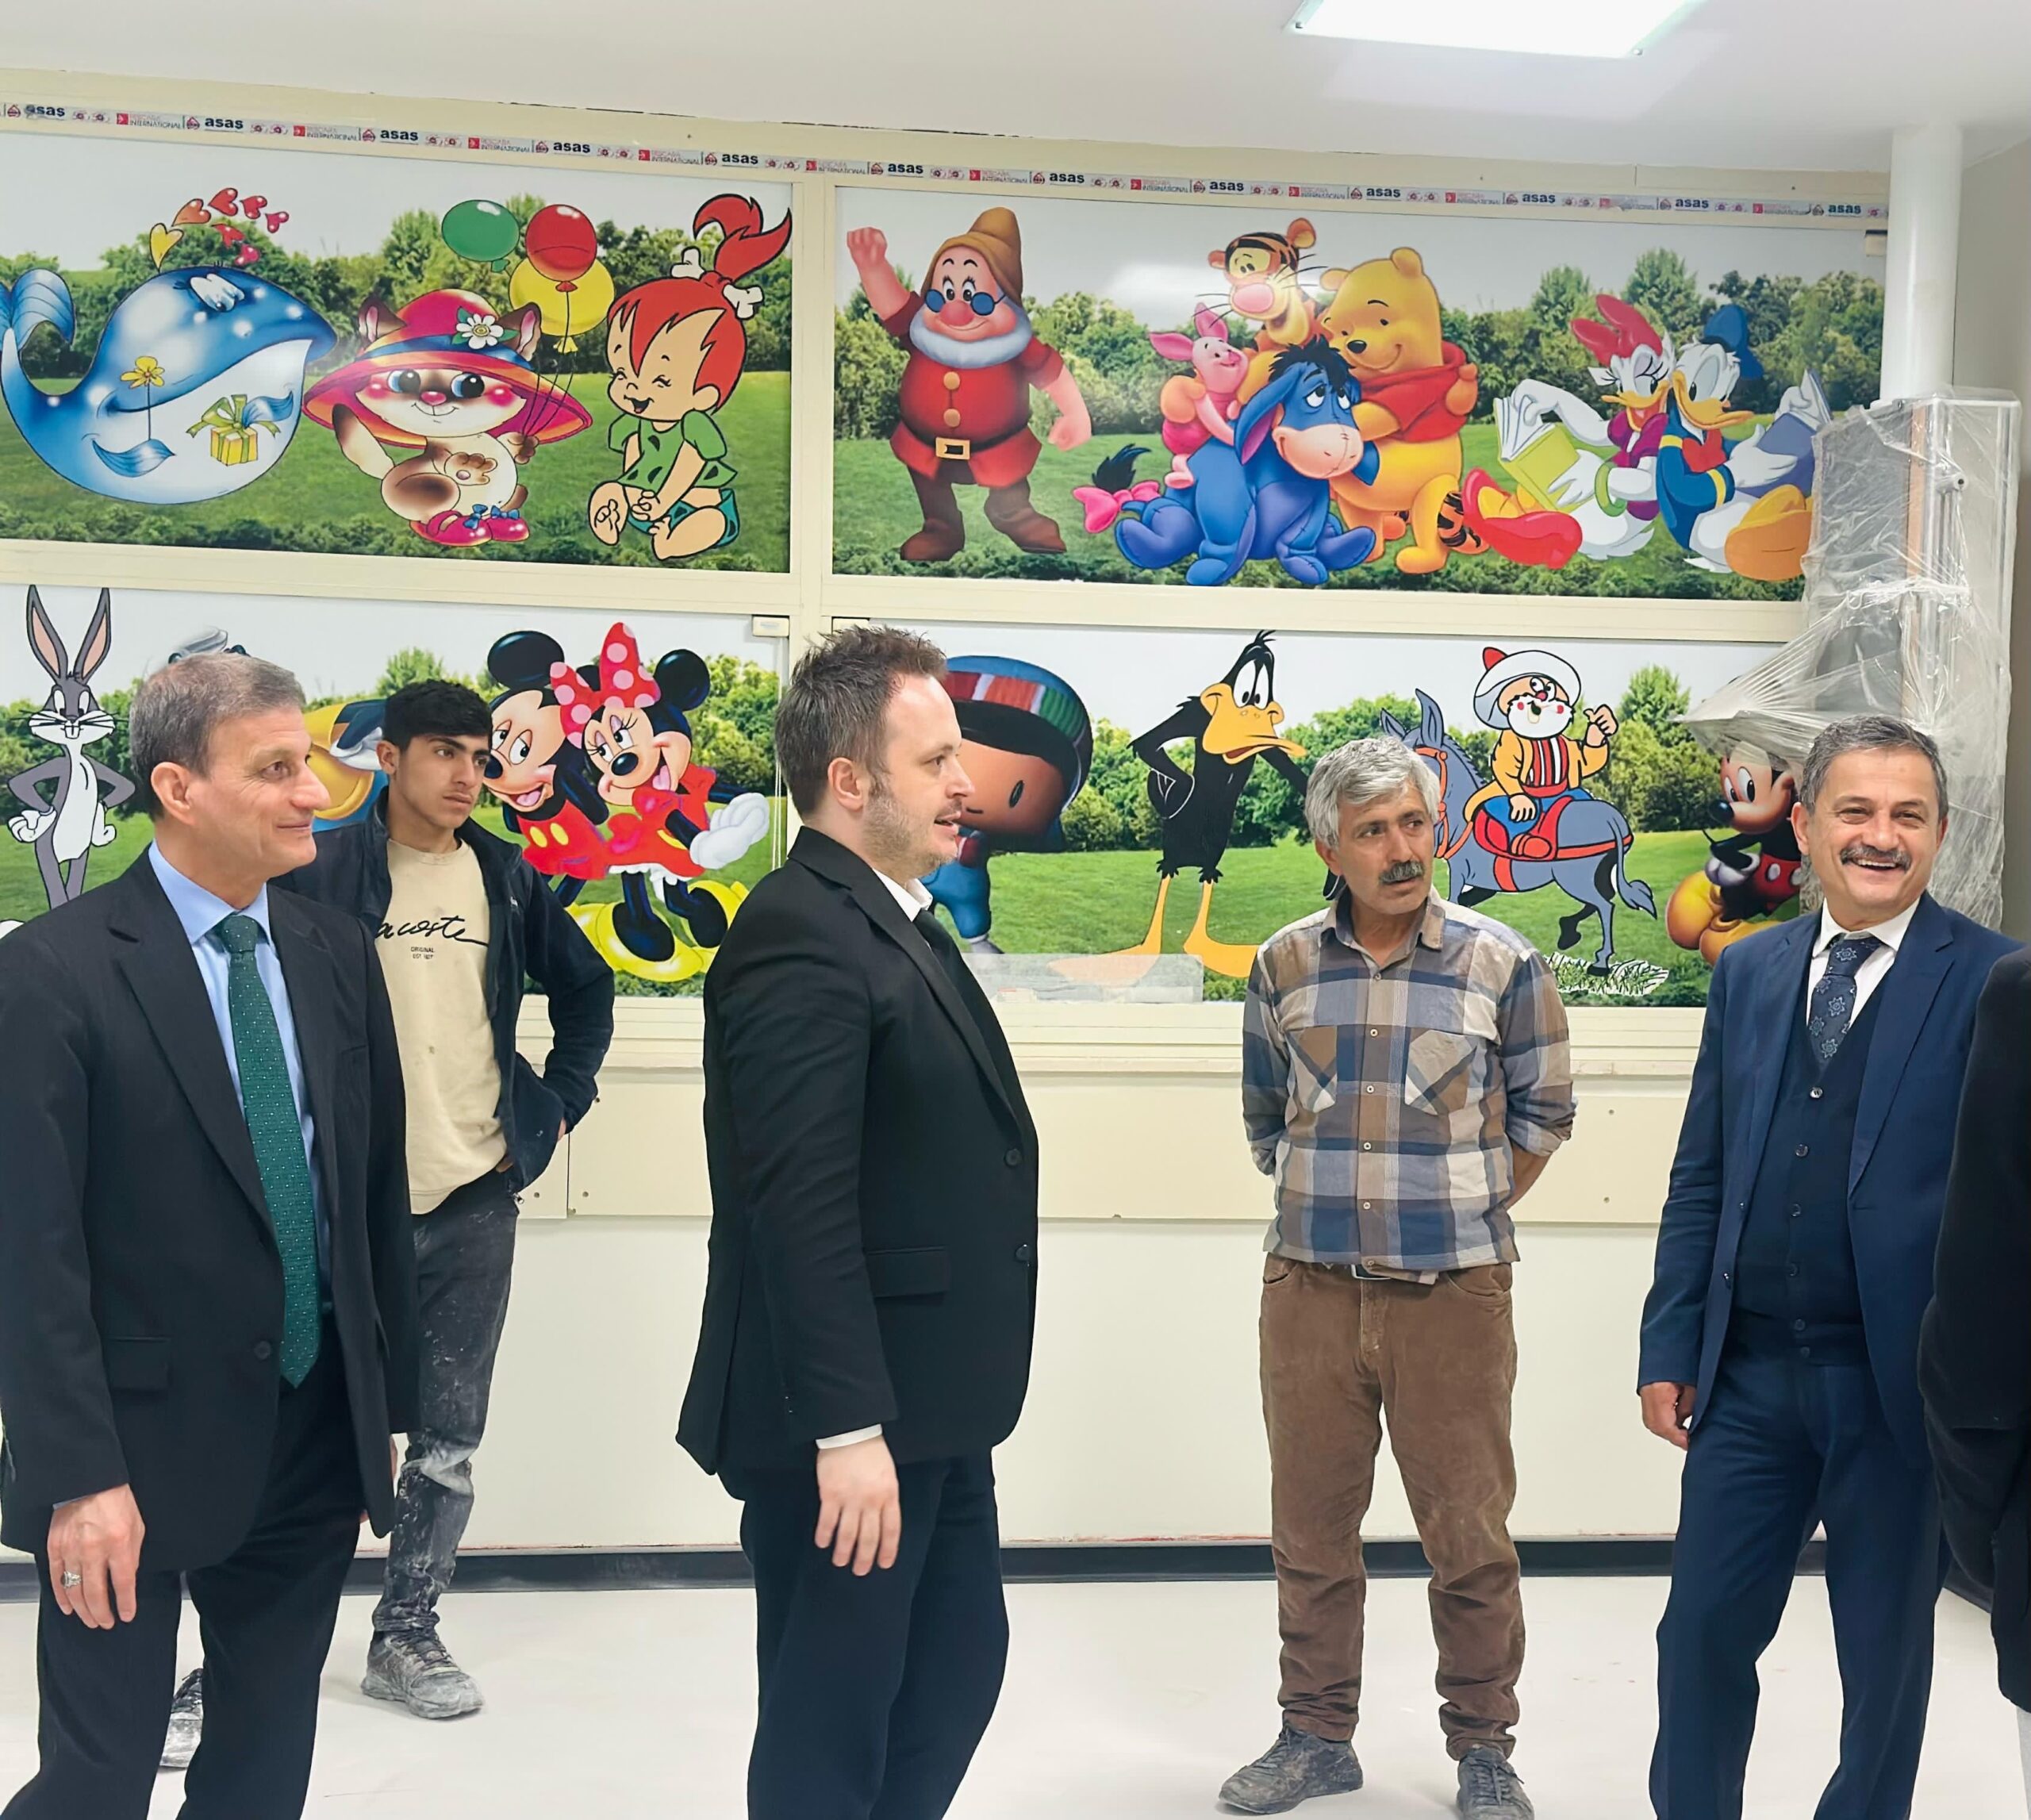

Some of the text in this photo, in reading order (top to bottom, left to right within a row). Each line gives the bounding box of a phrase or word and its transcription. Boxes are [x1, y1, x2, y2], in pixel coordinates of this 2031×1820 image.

[205, 117, 244, 129] asas
[380, 129, 418, 140] asas
[553, 142, 590, 153] asas
[722, 153, 758, 164] asas
[888, 163, 923, 174] asas
[1050, 173, 1085, 183] asas
[1210, 181, 1244, 191] asas
[1366, 188, 1400, 198] asas
[1522, 194, 1556, 203] asas
[1676, 198, 1709, 208] asas
[1828, 204, 1861, 214] asas
[374, 915, 489, 947] acoste
